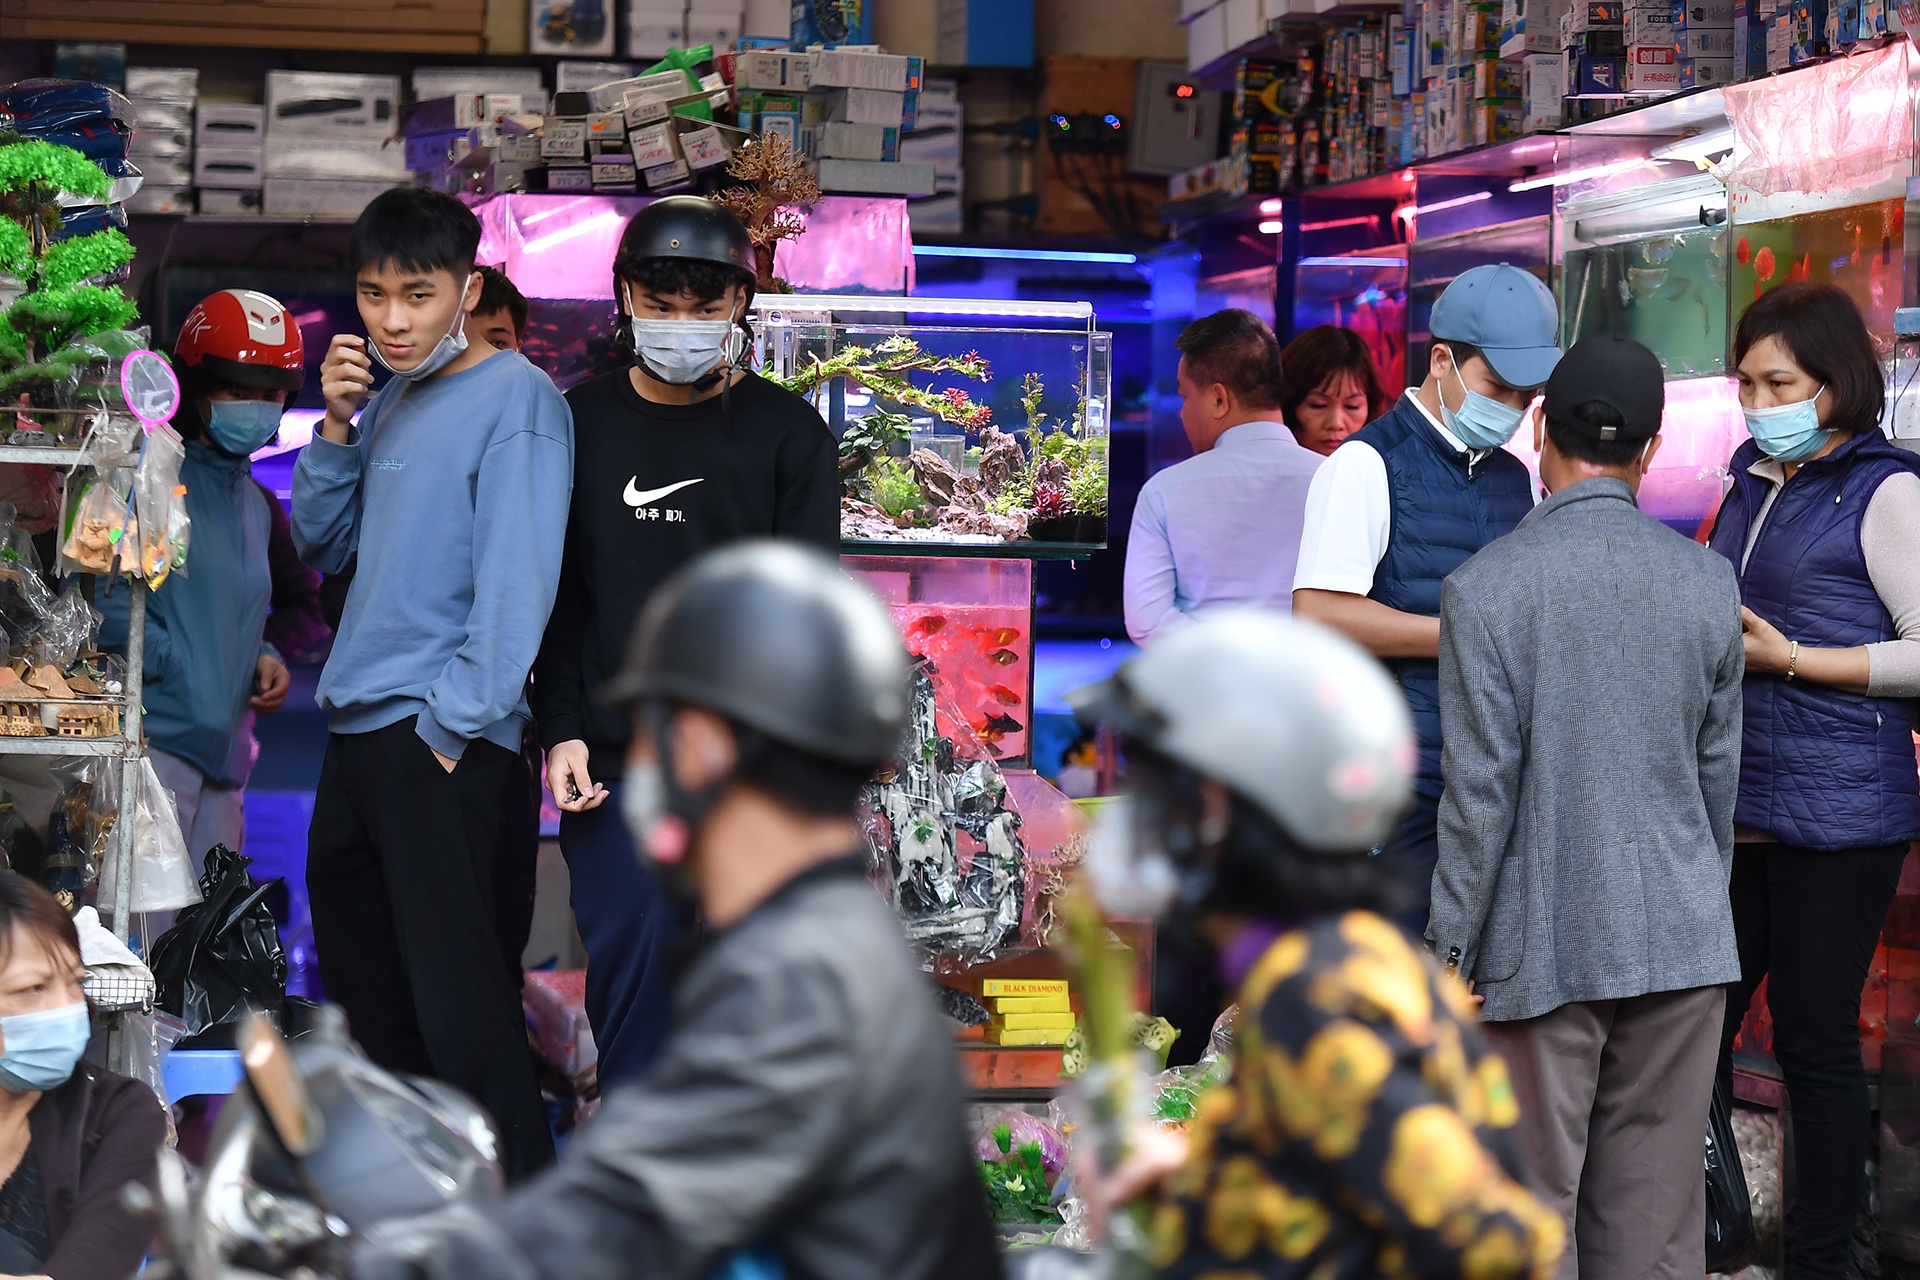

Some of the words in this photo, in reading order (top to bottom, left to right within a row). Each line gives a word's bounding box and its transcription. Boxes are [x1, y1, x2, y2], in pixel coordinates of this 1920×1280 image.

[635, 507, 660, 521] 아주
[1003, 984, 1026, 993] BLACK
[1029, 984, 1063, 993] DIAMOND
